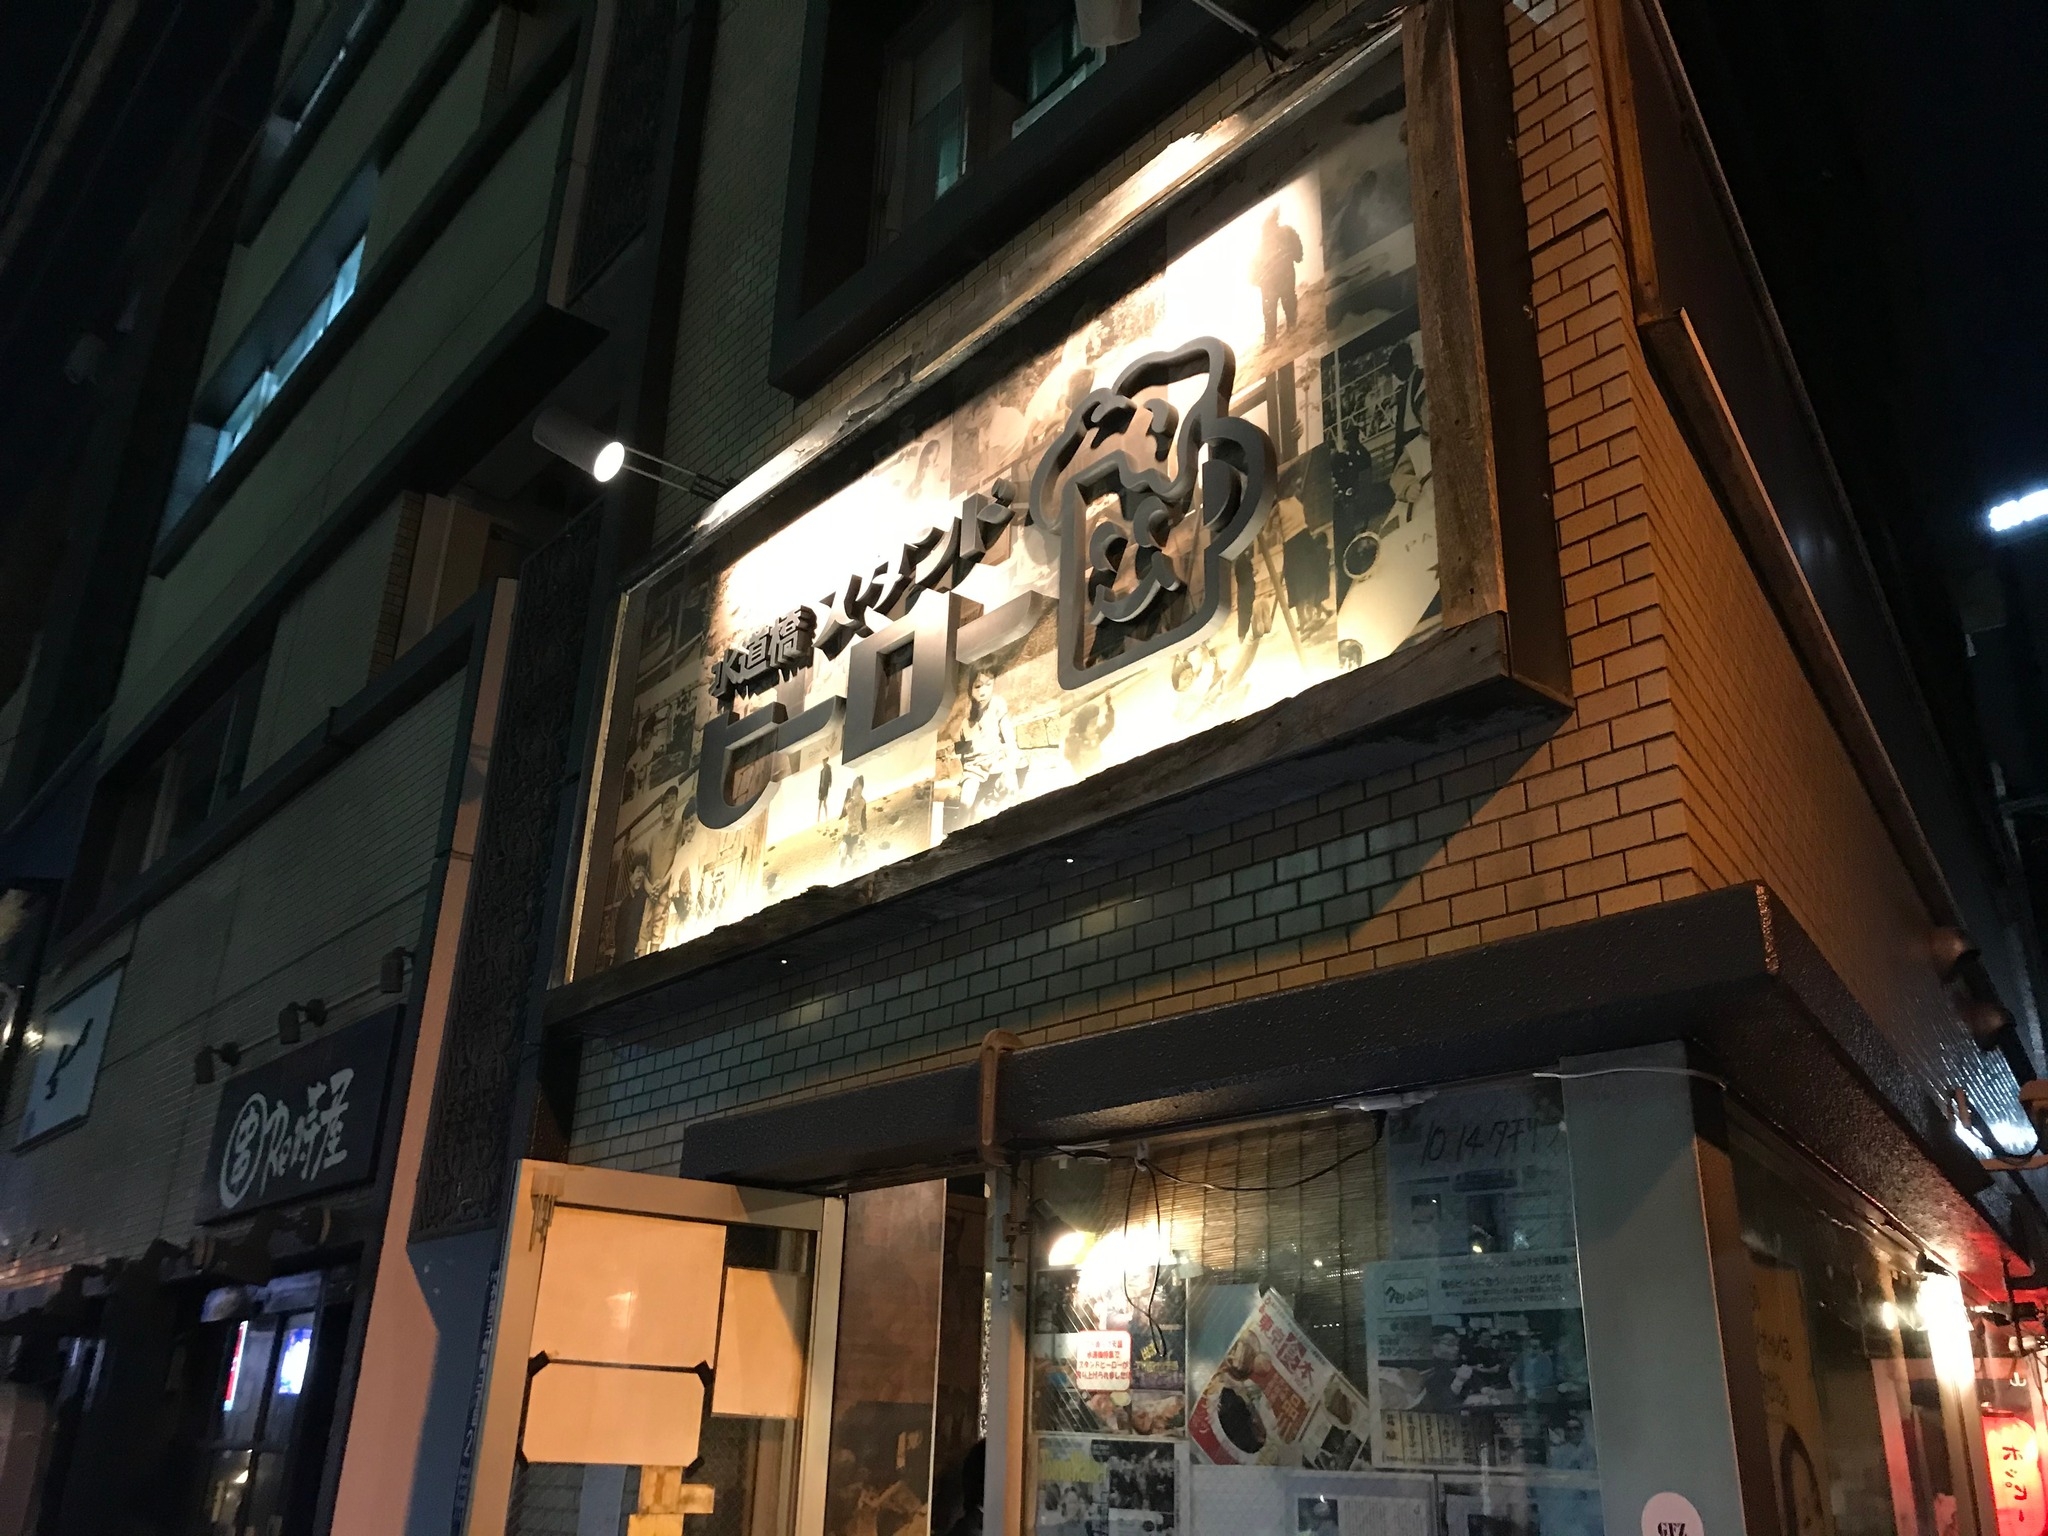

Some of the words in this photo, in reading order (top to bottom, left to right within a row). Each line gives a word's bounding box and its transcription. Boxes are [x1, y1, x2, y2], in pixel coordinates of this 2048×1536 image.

[708, 605, 812, 699] 水道橋
[813, 478, 1017, 660] スタンド
[698, 588, 1060, 831] ヒーロー
